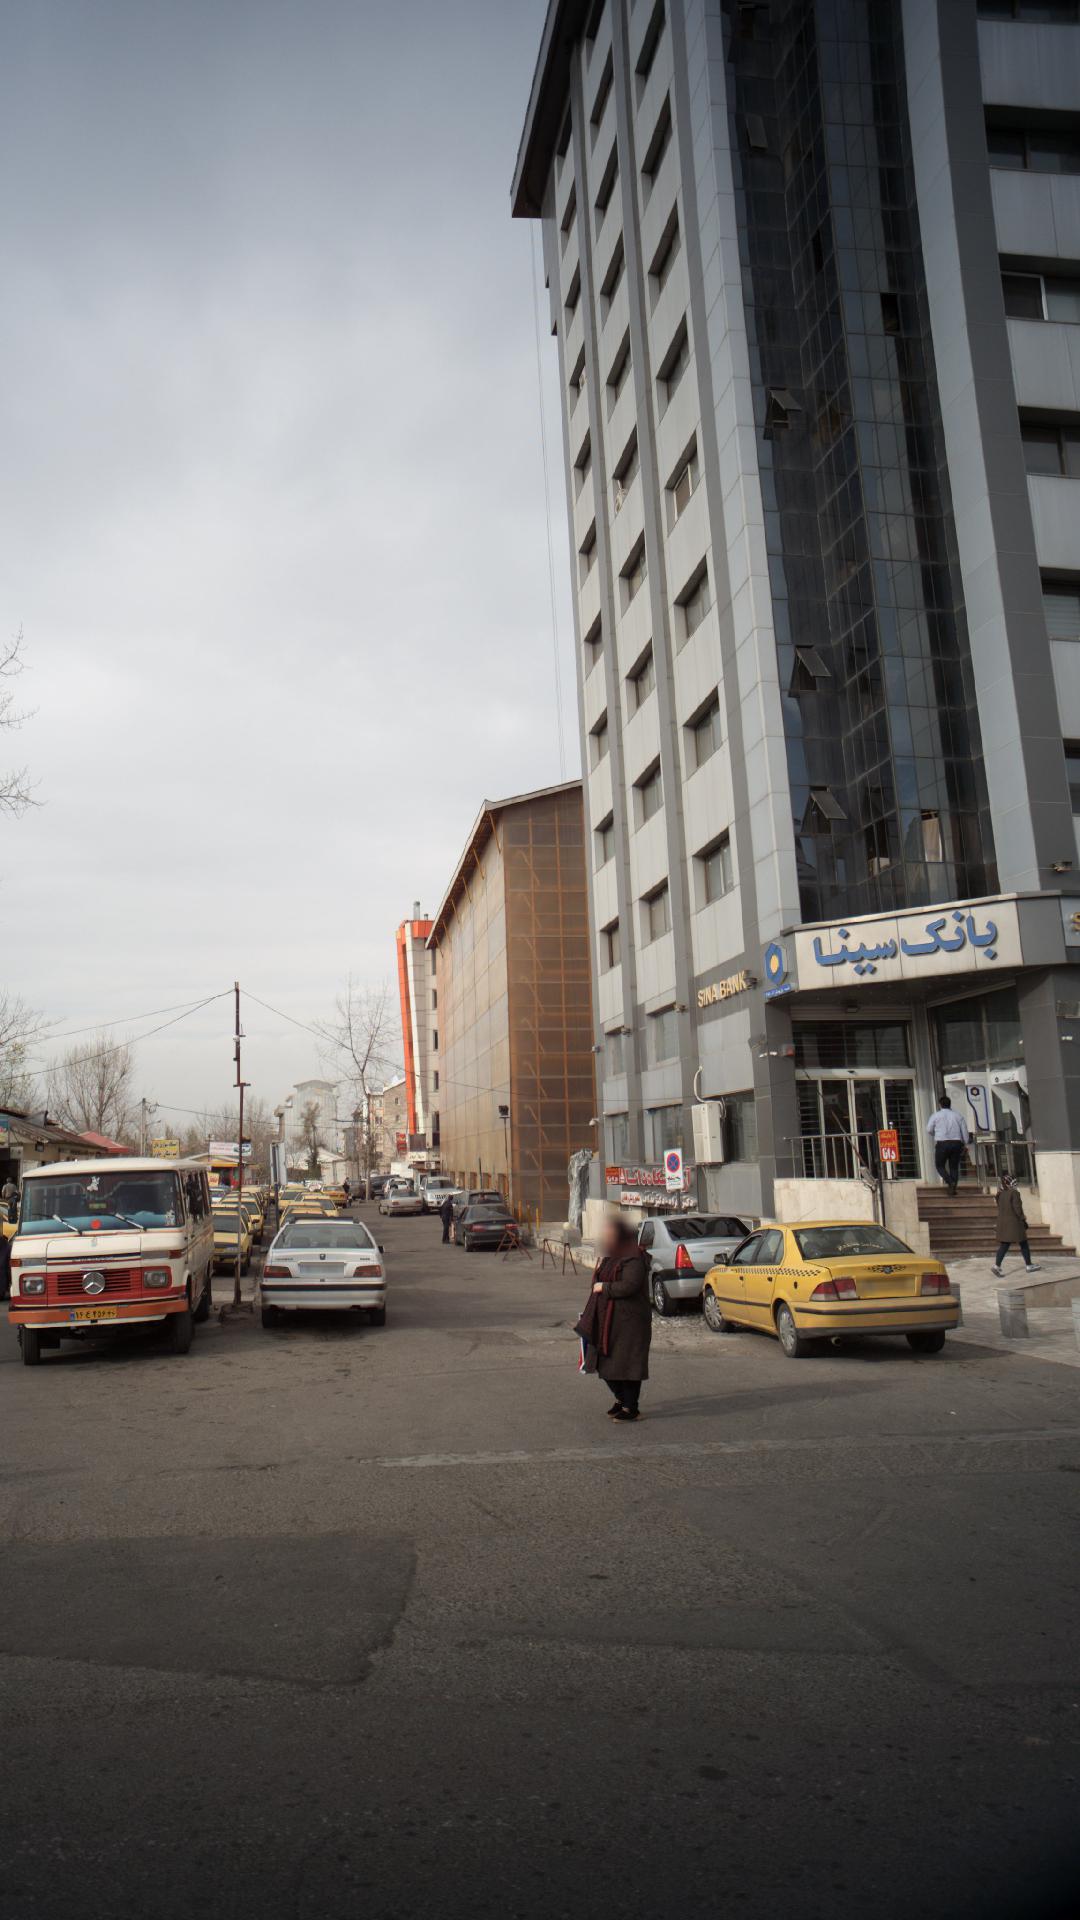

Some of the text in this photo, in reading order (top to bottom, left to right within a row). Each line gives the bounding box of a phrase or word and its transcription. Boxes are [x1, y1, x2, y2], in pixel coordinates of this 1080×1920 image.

[812, 910, 998, 976] بانک سینا
[697, 983, 717, 1008] SINA
[720, 970, 747, 998] BANK
